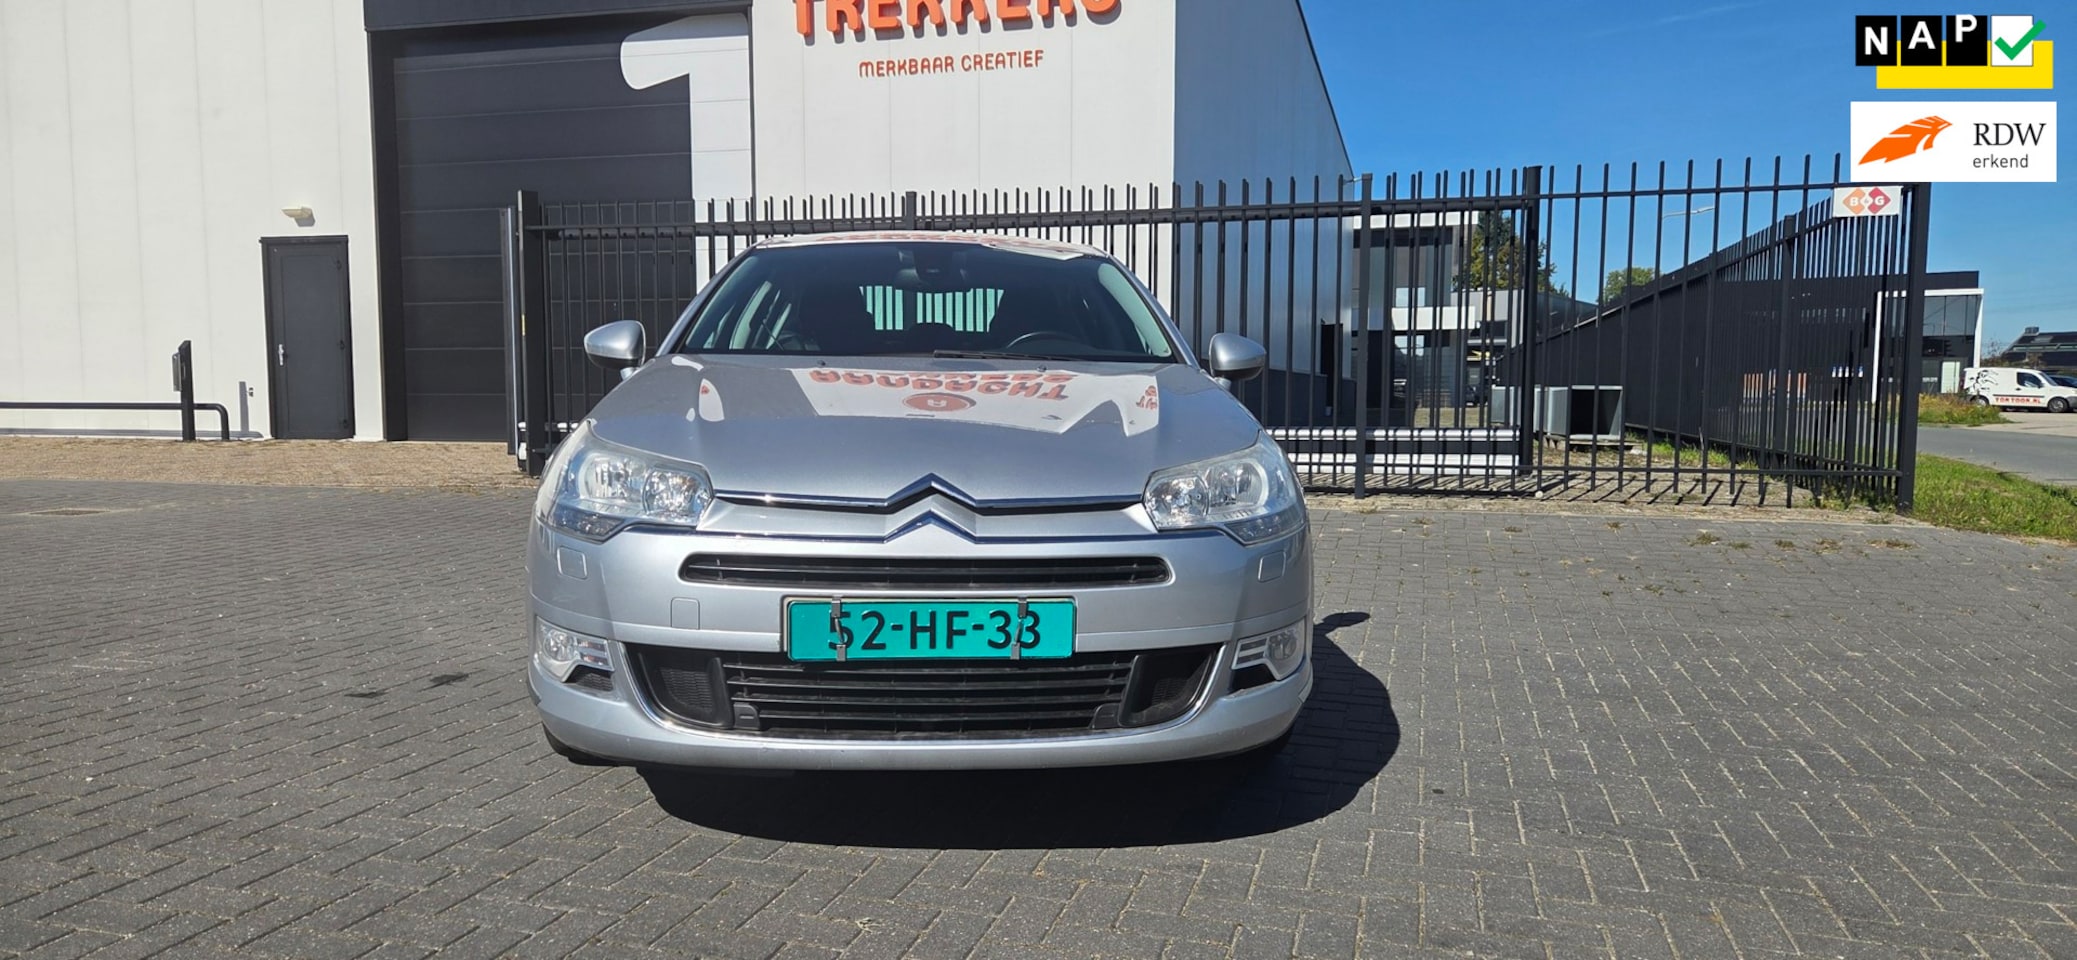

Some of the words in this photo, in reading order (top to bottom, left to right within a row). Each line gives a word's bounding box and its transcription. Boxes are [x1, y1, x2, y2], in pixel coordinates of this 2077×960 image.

[858, 55, 955, 78] MERKBAAR
[961, 49, 1045, 72] CREATIEF
[828, 610, 1041, 650] 52-HF-33
